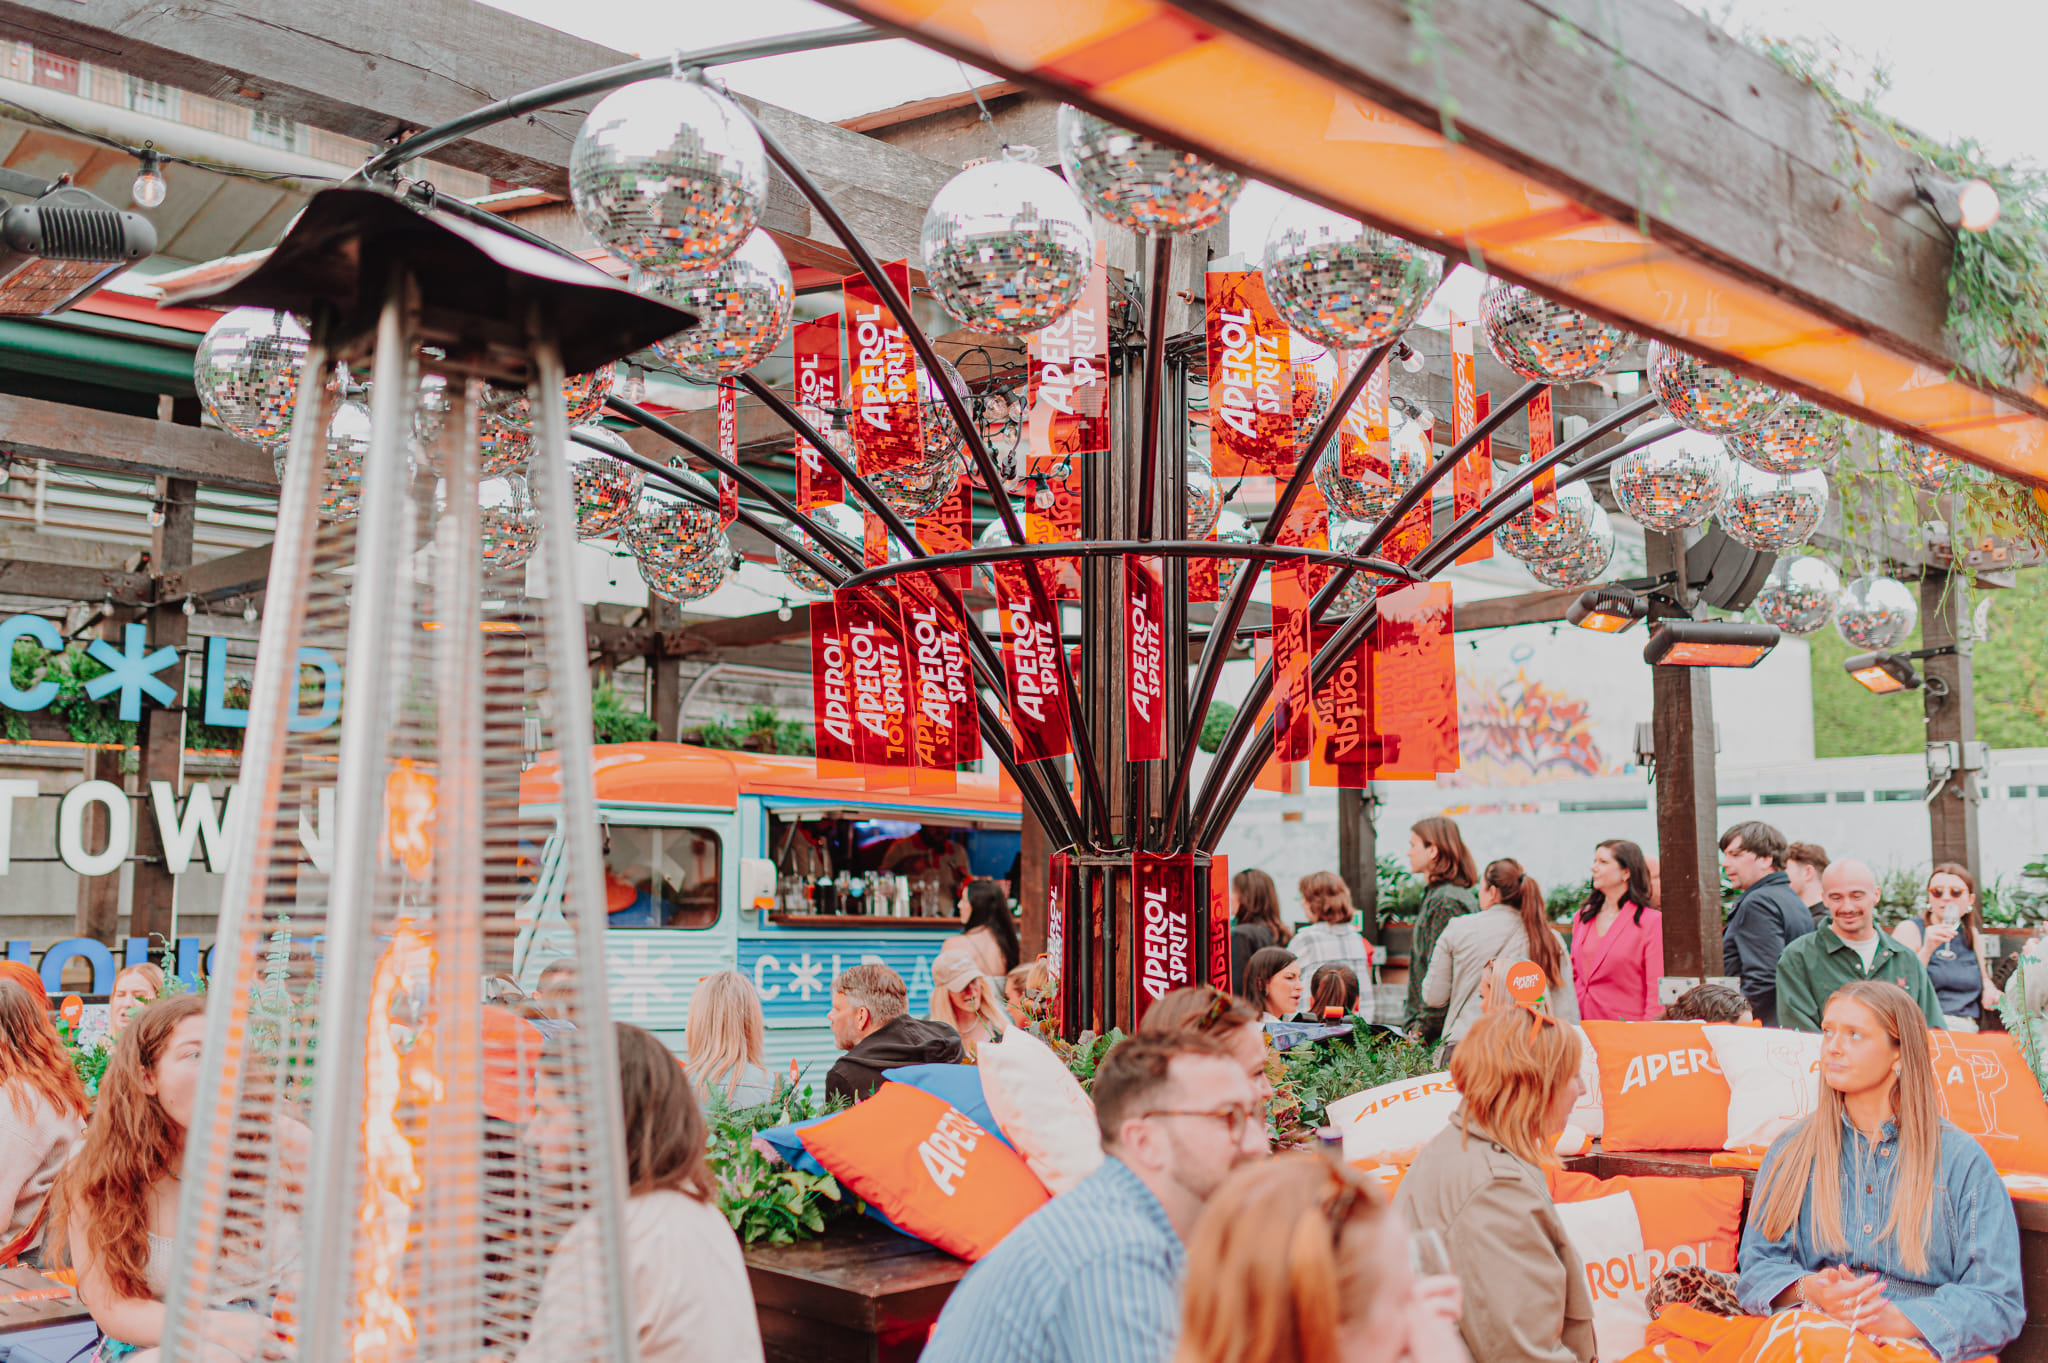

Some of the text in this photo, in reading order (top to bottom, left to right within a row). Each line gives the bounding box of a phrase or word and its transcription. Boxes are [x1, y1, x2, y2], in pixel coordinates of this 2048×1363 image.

[856, 304, 891, 432] APEROL
[883, 326, 908, 402] SPRITZ
[1072, 308, 1096, 387] SPRITZ
[1220, 307, 1257, 439] APEROL
[1254, 334, 1281, 414] SPRITZ
[849, 621, 890, 738] APEROL
[879, 644, 906, 714] SPRITZ
[912, 606, 953, 729] APEROL
[941, 630, 968, 704] SPRITZ
[1009, 596, 1046, 723] APEROL
[1034, 620, 1059, 696] SPRITZ
[1131, 592, 1151, 723] APEROL
[1149, 620, 1161, 699] SPRITZ
[1143, 886, 1170, 1001] APEROL
[1168, 911, 1188, 983] SPRITZ
